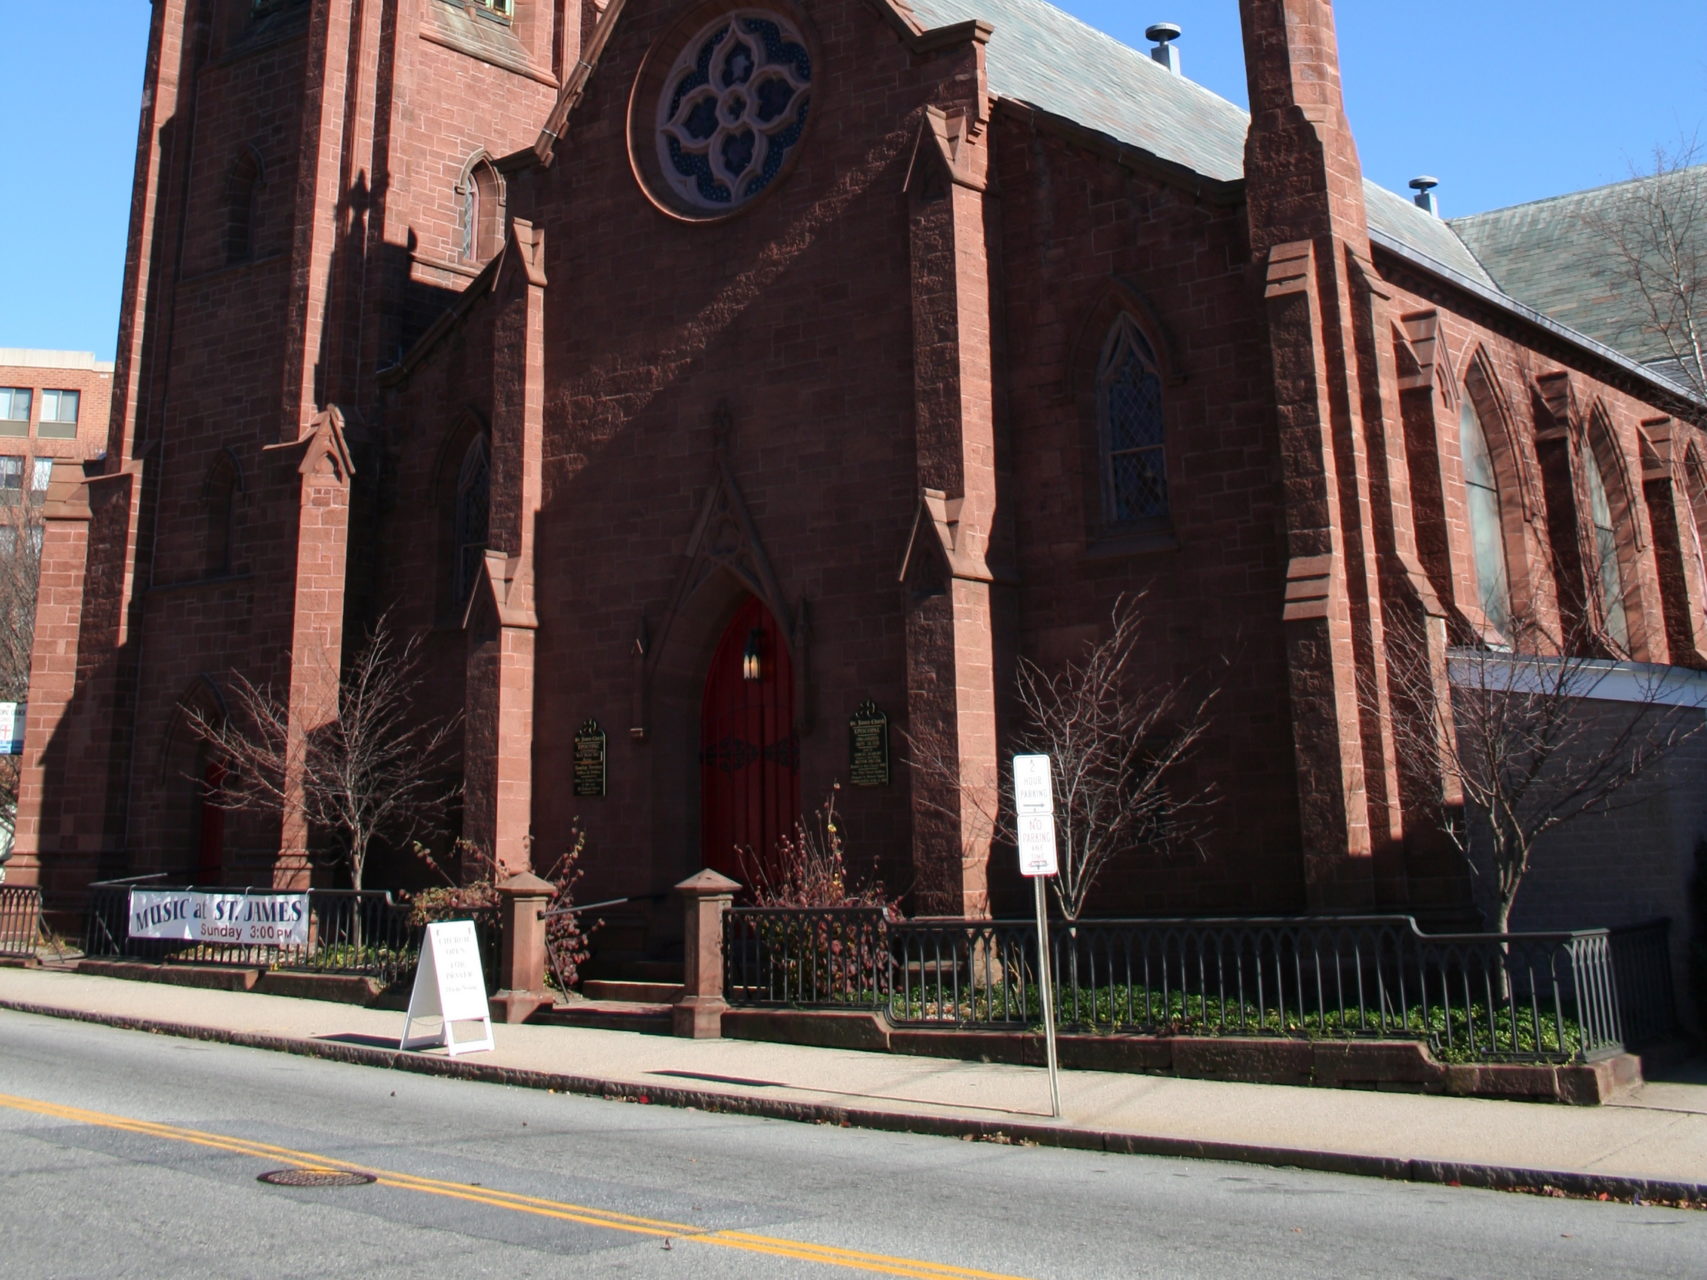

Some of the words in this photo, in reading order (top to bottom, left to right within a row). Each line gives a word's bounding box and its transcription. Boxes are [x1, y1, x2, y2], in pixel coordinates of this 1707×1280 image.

[1023, 776, 1042, 786] HOUR
[1020, 789, 1048, 800] PARKING
[1029, 819, 1043, 831] NO
[1023, 831, 1051, 843] PARKING
[135, 898, 190, 933] MUSIC
[193, 901, 207, 920] at
[214, 899, 239, 922] ST.
[243, 899, 302, 923] JAMES
[200, 923, 243, 941] Sunday
[249, 924, 275, 940] 3:00
[276, 928, 293, 939] PM
